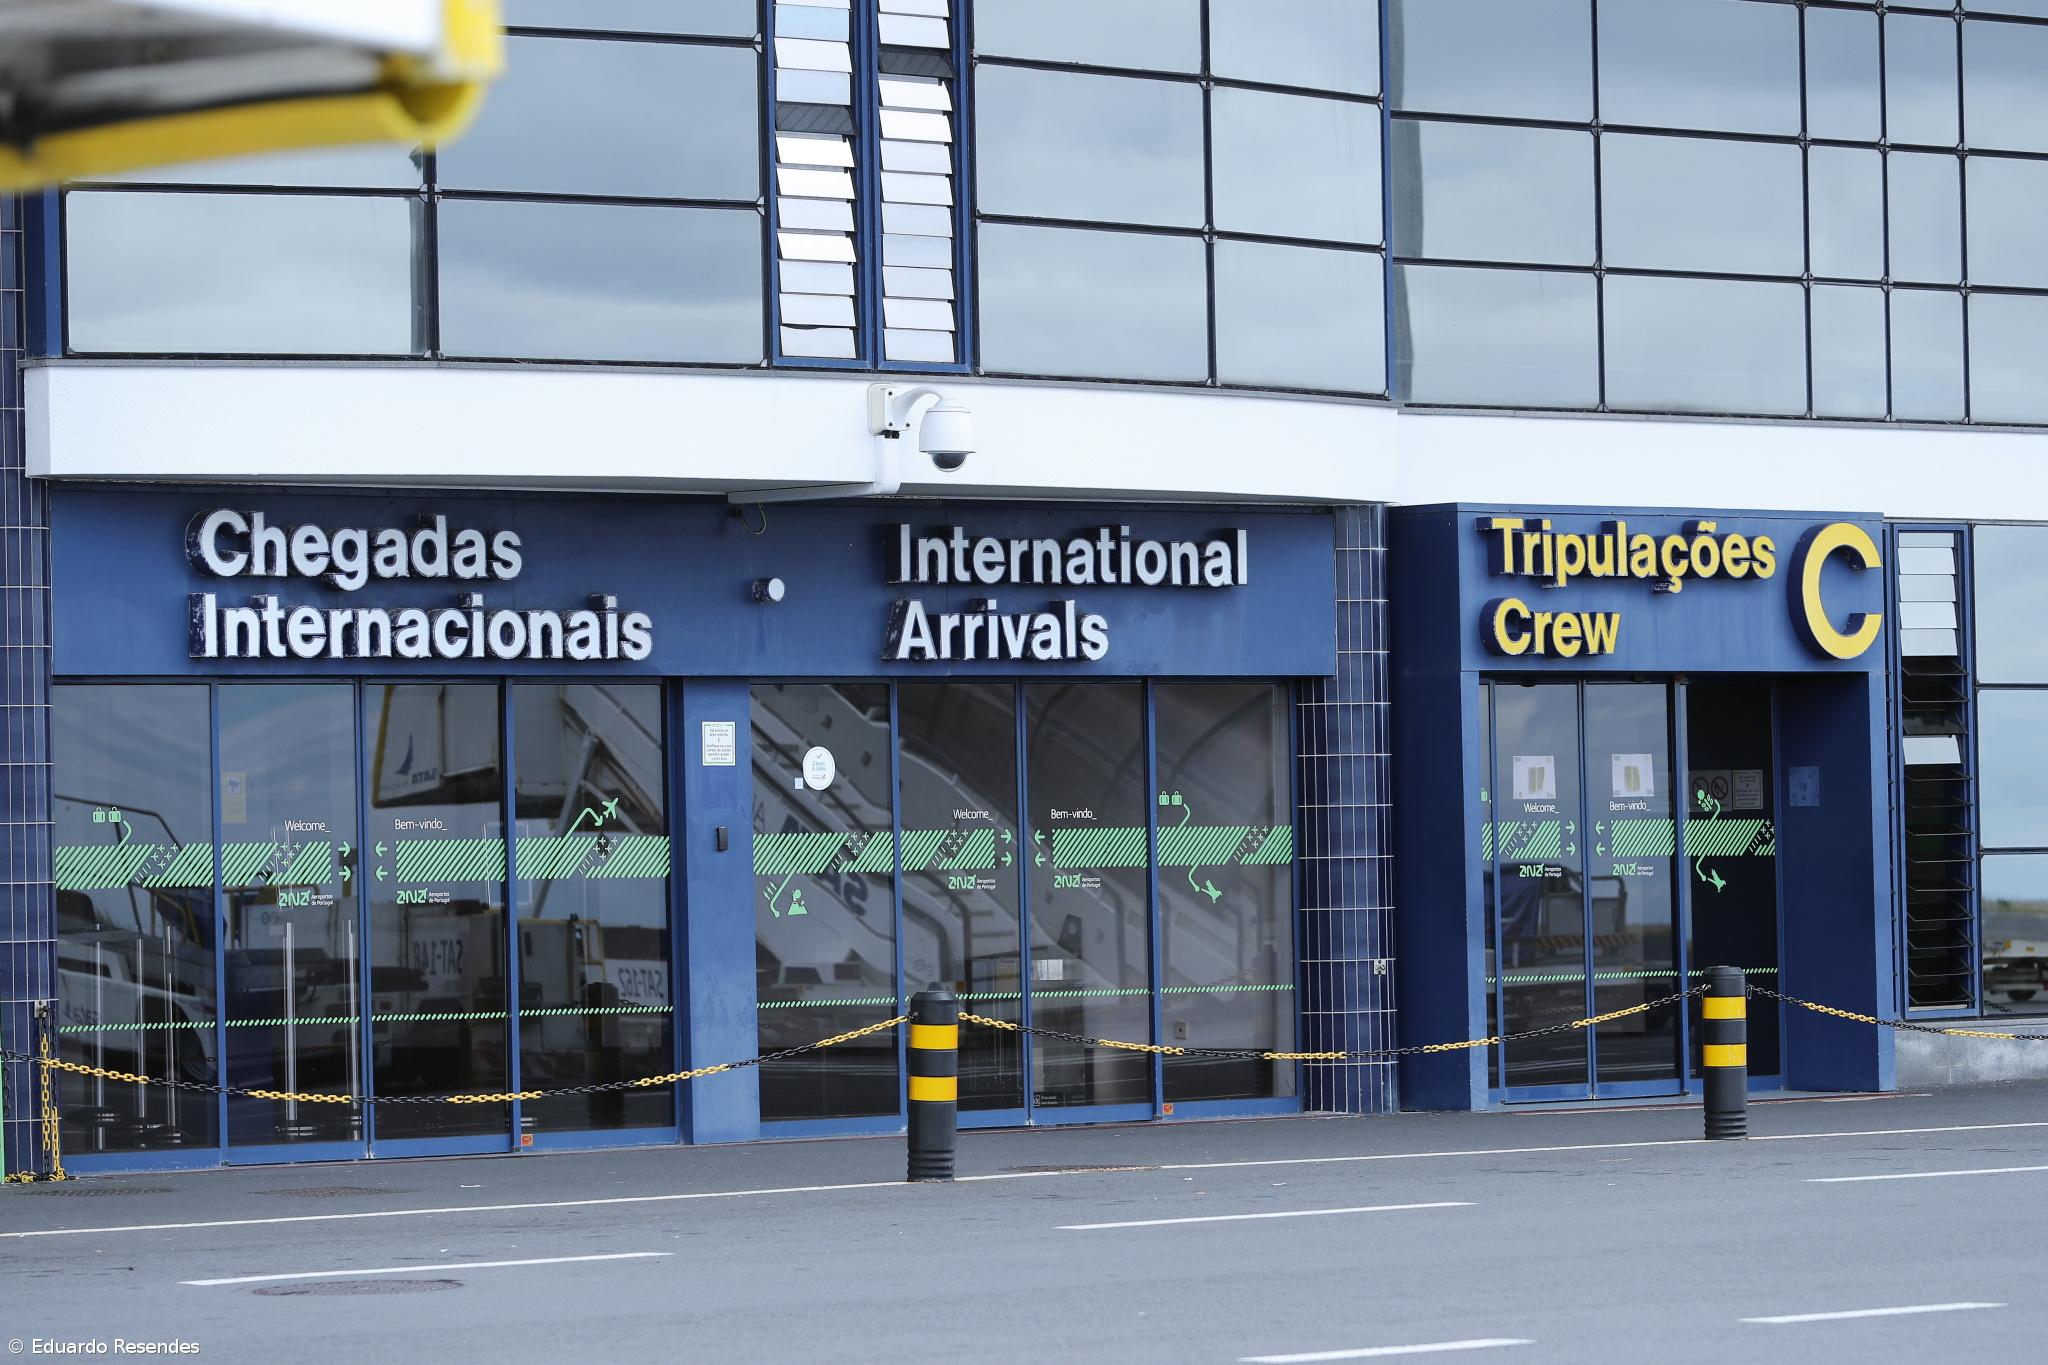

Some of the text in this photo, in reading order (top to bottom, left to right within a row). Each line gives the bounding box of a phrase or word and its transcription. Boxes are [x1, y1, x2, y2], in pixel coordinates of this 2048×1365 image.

[197, 508, 524, 592] Chegadas
[899, 522, 1248, 588] International
[1490, 516, 1777, 594] Tripulações
[1802, 521, 1882, 660] C
[202, 593, 654, 662] Internacionais
[895, 598, 1109, 661] Arrivals
[1492, 596, 1621, 658] Crew
